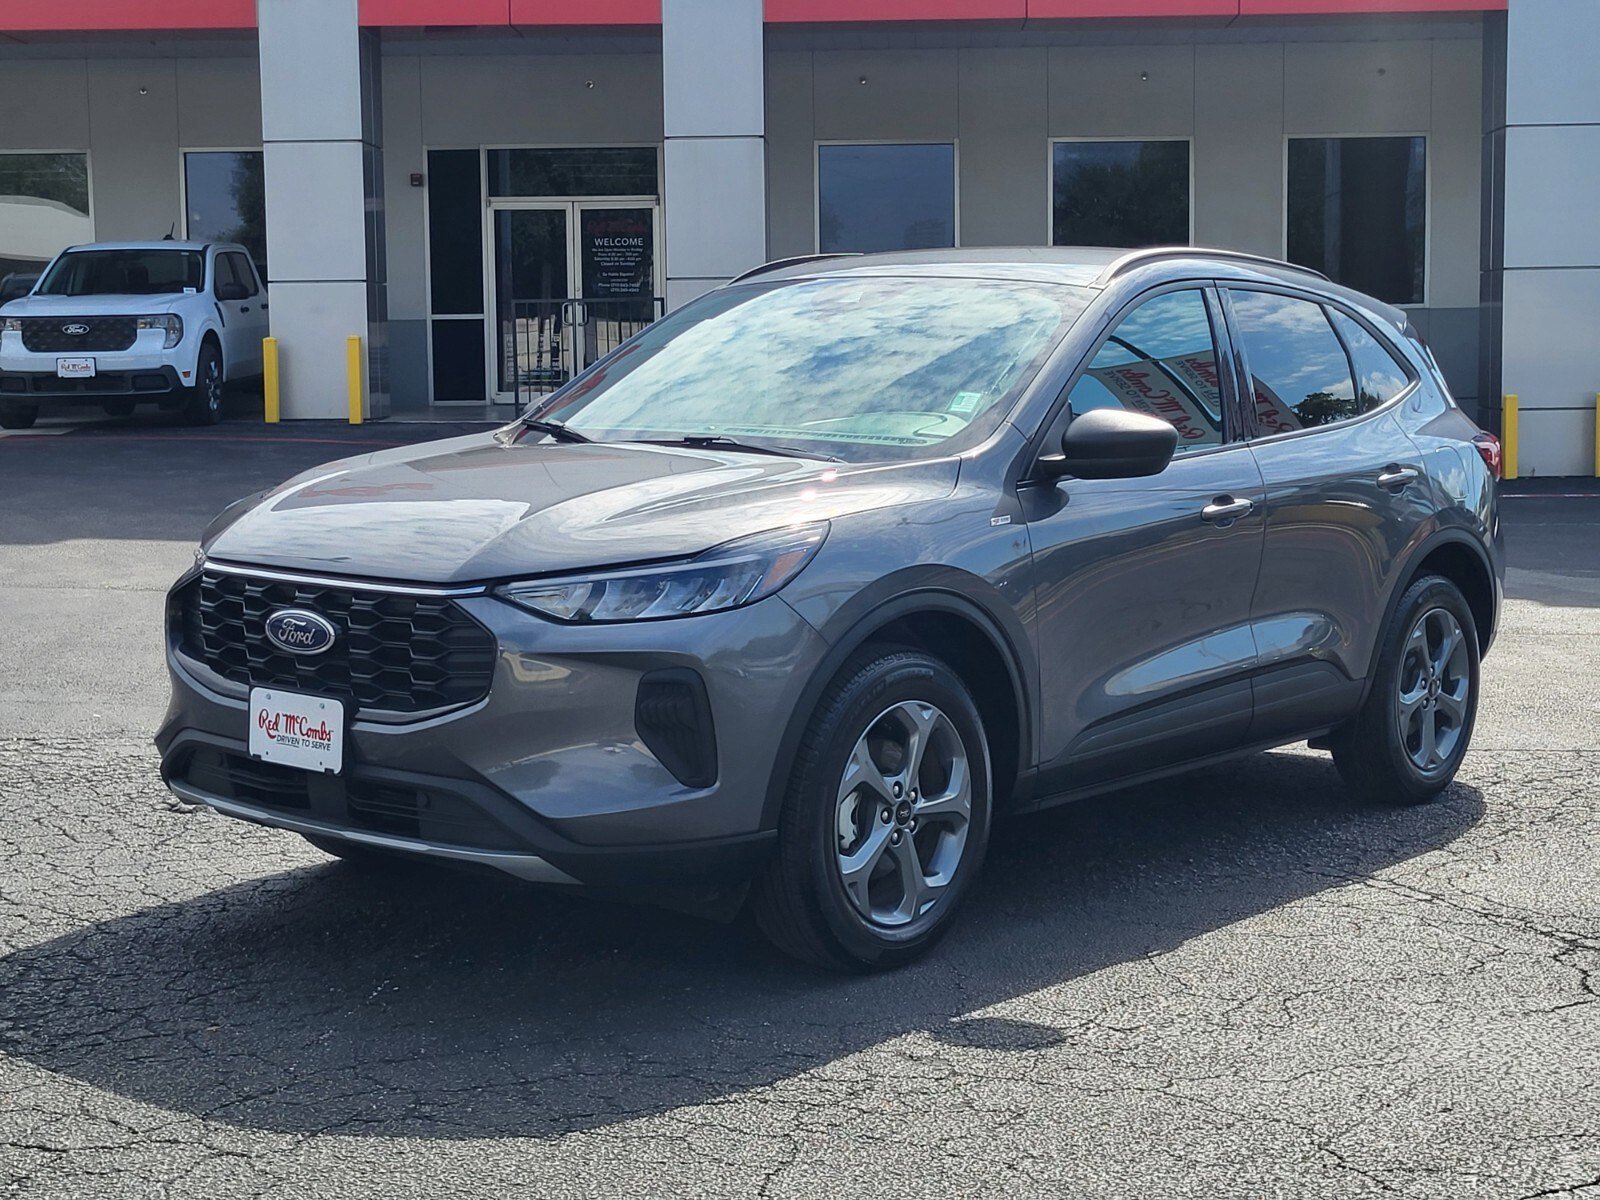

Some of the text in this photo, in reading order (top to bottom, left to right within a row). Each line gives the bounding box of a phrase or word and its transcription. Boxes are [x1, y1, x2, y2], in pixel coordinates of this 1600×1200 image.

[594, 237, 644, 246] WELCOME
[278, 618, 316, 645] Ford
[258, 708, 281, 739] Red
[276, 734, 331, 752] DRIVEN TO SERVE
